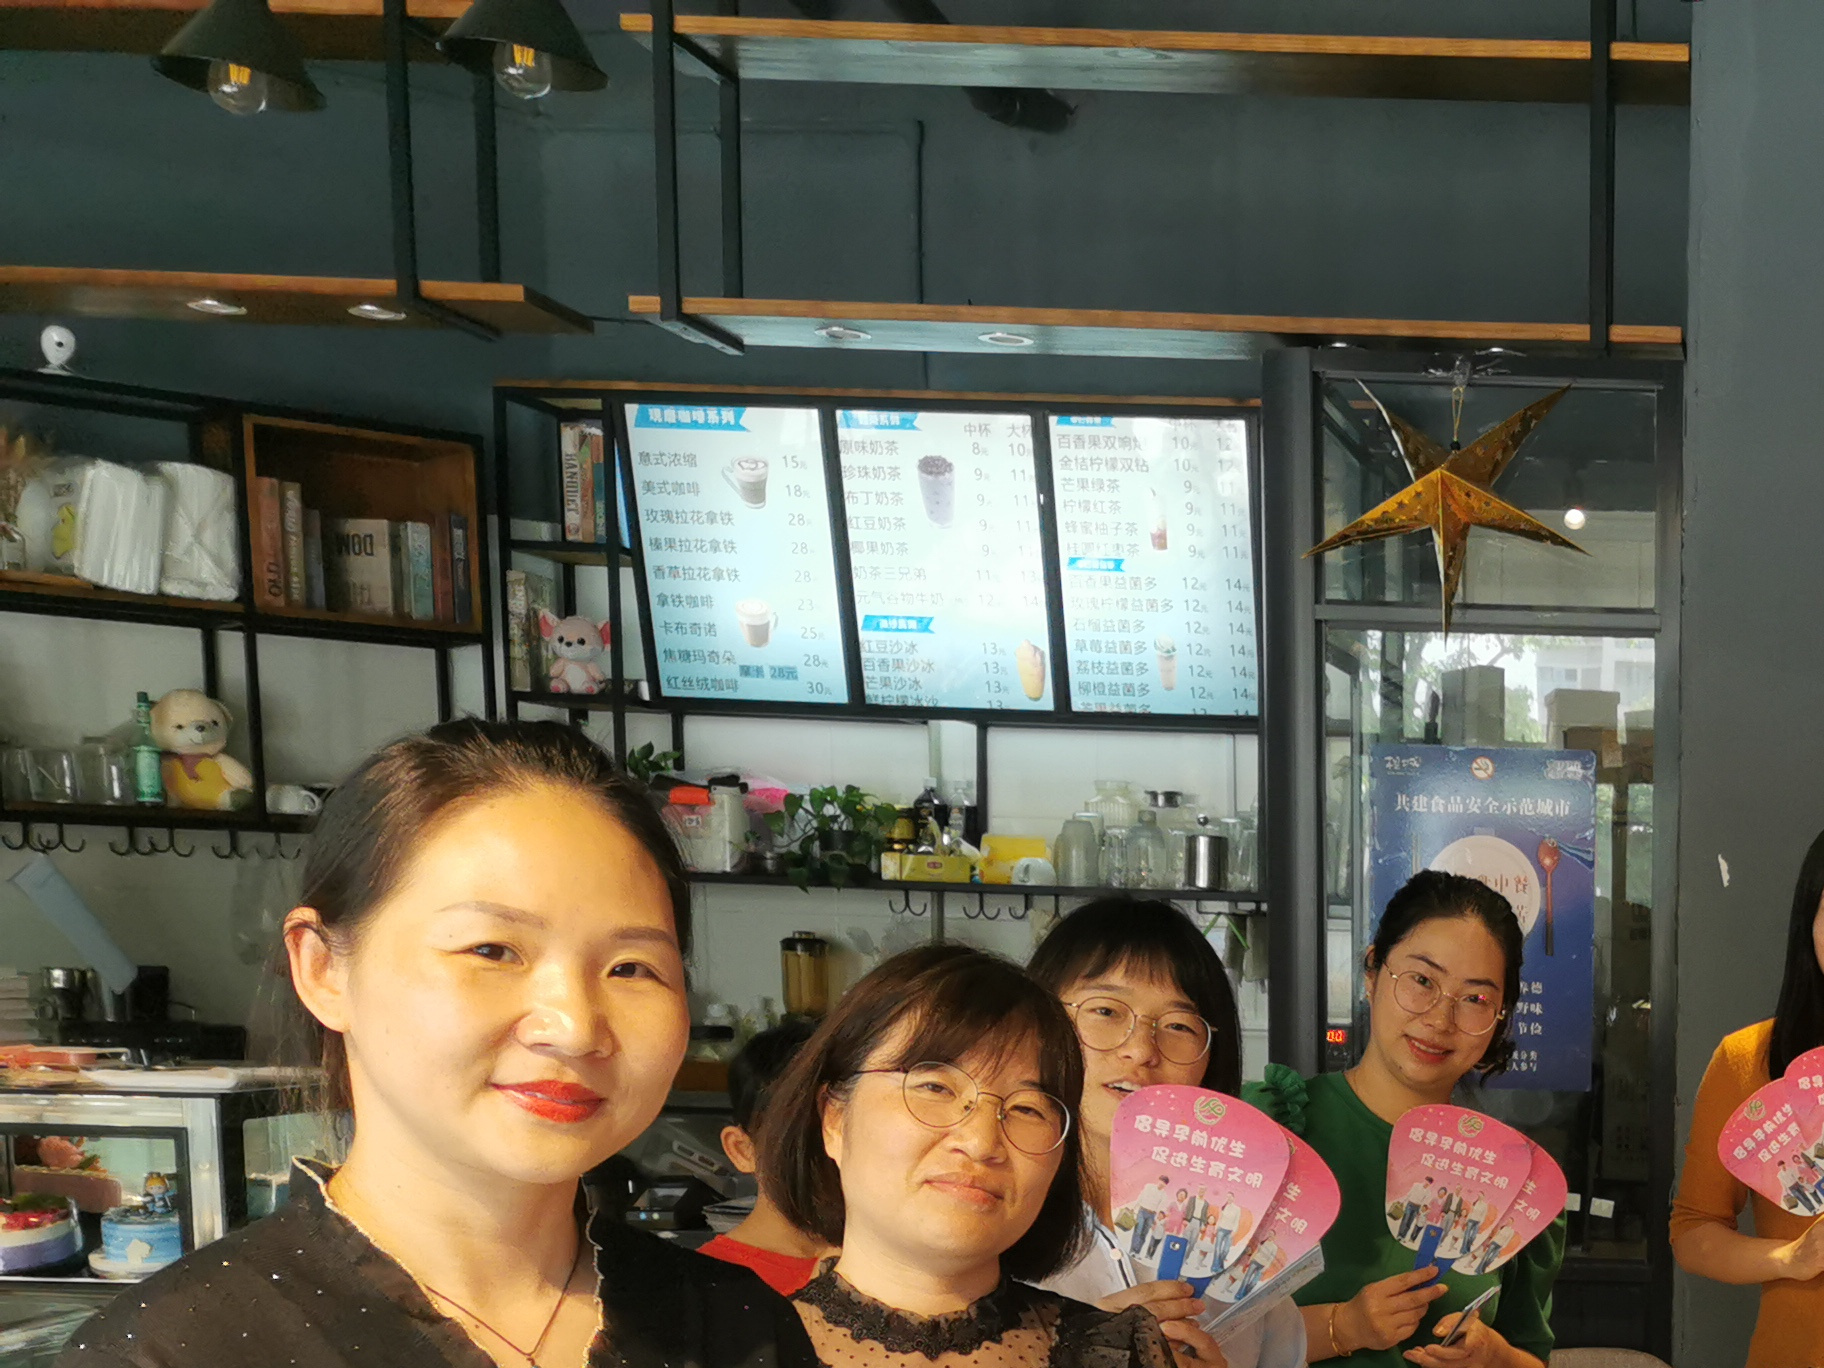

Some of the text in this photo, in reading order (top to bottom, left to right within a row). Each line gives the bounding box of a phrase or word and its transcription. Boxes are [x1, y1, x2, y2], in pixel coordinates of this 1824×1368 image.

[964, 423, 991, 437] 中杯
[840, 440, 899, 455] 原味奶茶
[638, 452, 697, 467] 意式浓缩
[1059, 456, 1149, 472] 金桔柠檬双钻
[843, 466, 901, 480] 珍珠奶茶
[642, 480, 700, 495] 美式咖啡
[1061, 478, 1120, 492] 芒果绿茶
[846, 492, 904, 506] 布丁奶茶
[1063, 500, 1121, 514] 柠檬红茶
[645, 509, 735, 525] 玫瑰拉花拿铁
[849, 517, 906, 531] 红豆奶茶
[1065, 522, 1138, 536] 蜂蜜柚子茶
[649, 537, 737, 554] 榛果拉花拿铁
[851, 542, 908, 556] 椰果奶茶
[653, 566, 740, 582] 香草拉花拿铁
[853, 566, 926, 580] 奶茶三兄弟
[657, 593, 714, 608] 拿铁咖啡
[660, 621, 717, 637] 卡布奇诺
[861, 640, 918, 655] 红豆沙冰
[1074, 639, 1147, 654] 草莓益菌多
[663, 650, 735, 665] 焦糖玛奇朵
[864, 658, 935, 674] 百香果沙冰
[1076, 660, 1149, 676] 荔枝益菌多
[666, 677, 739, 692] 红丝绒咖啡
[866, 677, 922, 691] 芒果沙冰
[1079, 682, 1150, 696] 柳橙益菌多
[1395, 793, 1570, 817] 共建食品安全示范城市
[1134, 1114, 1246, 1158] 倡导孕前优生
[1409, 1128, 1497, 1165] 倡导孕前优生
[1151, 1146, 1263, 1188] 促进生育文明
[1421, 1154, 1509, 1189] 促进生育文明
